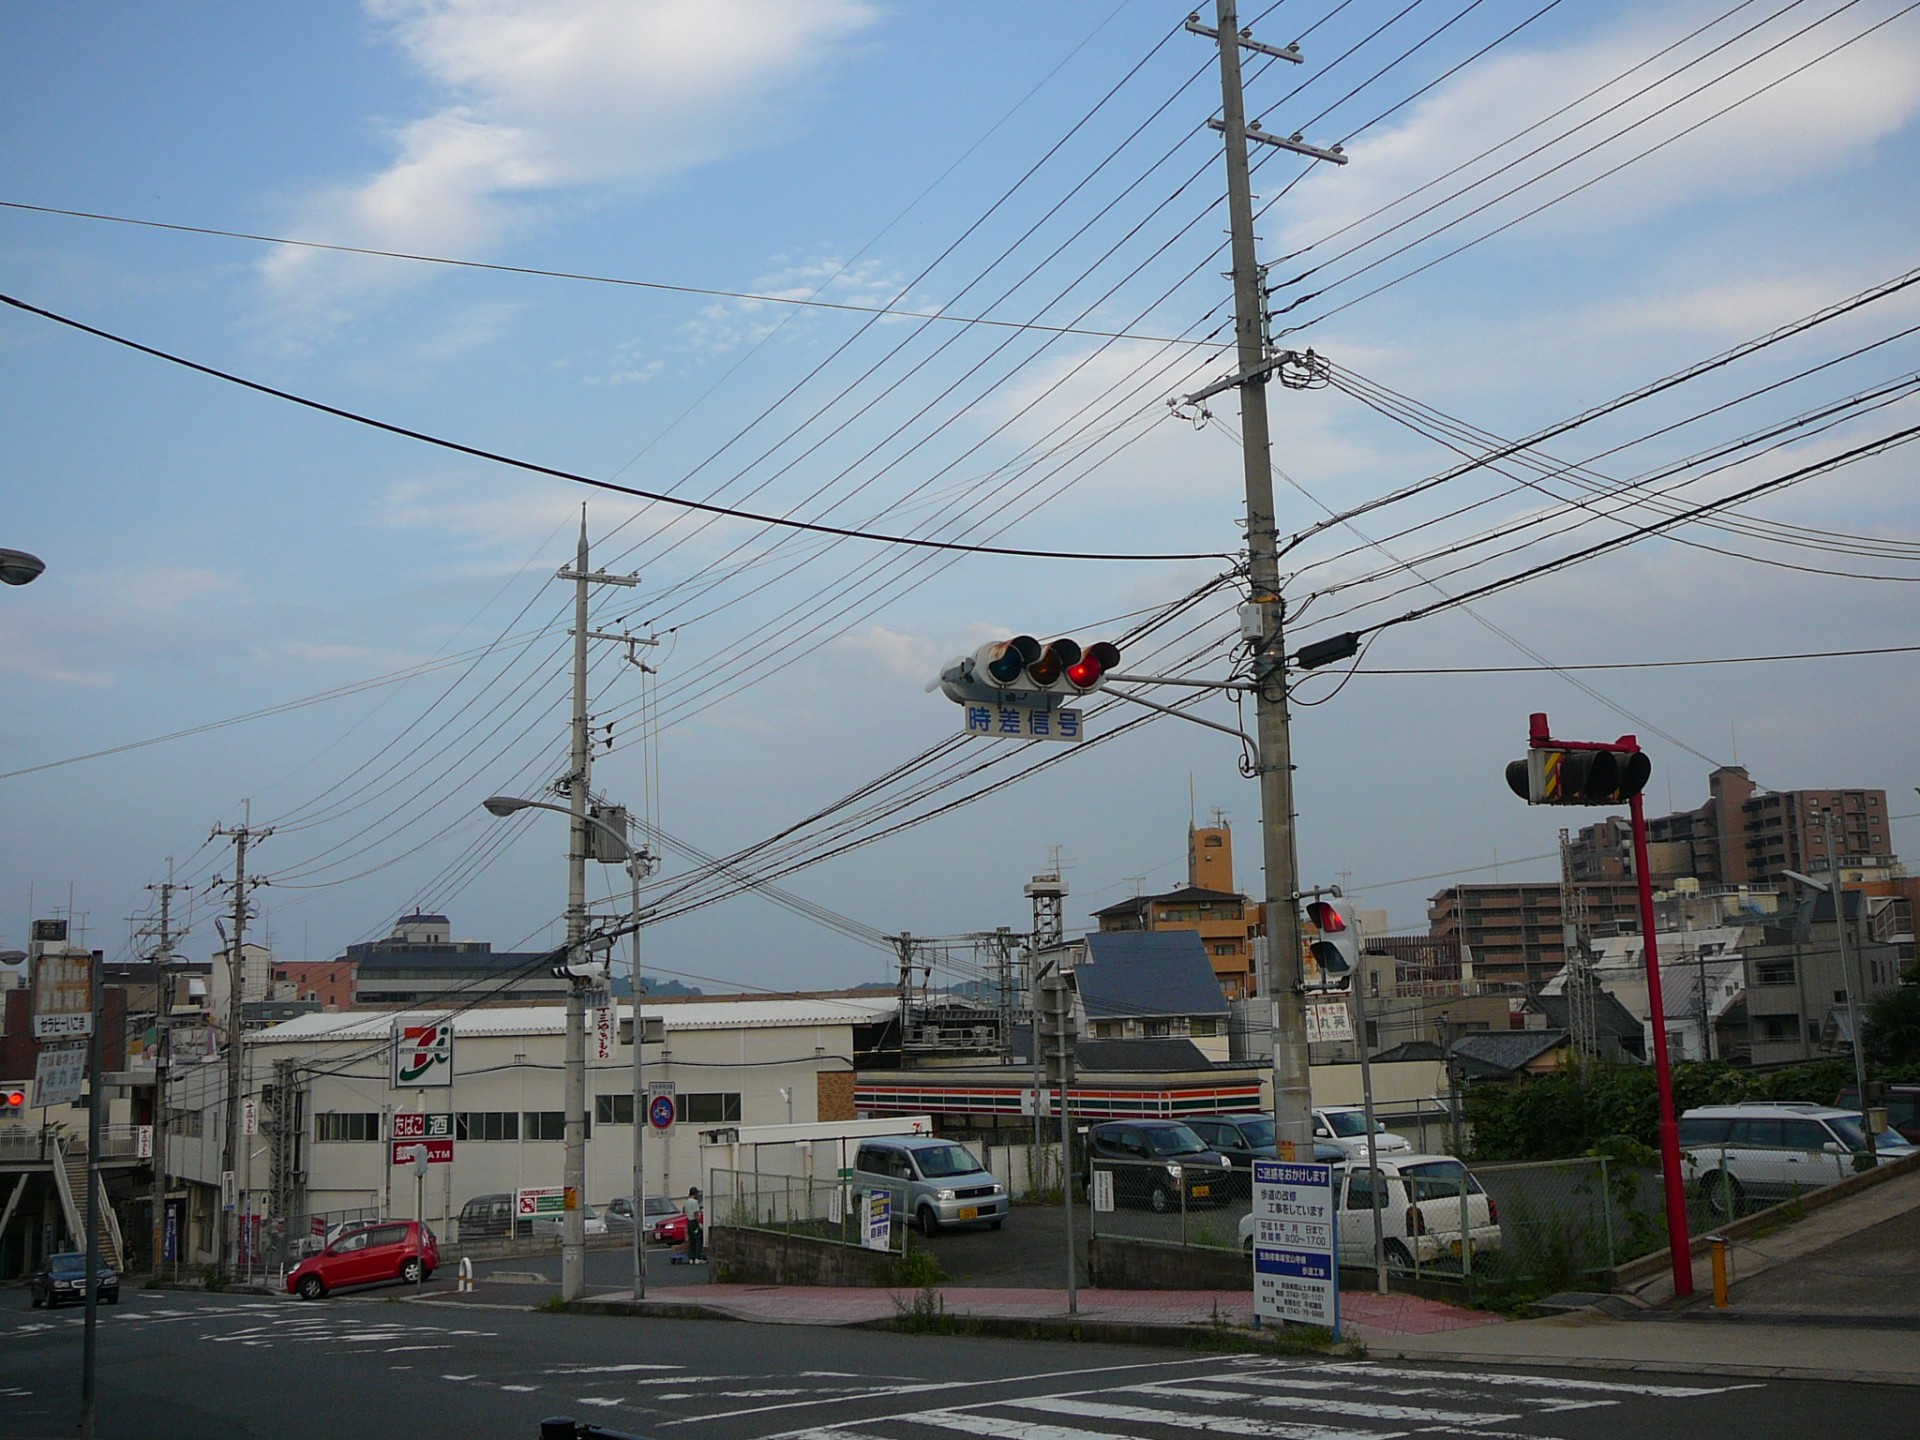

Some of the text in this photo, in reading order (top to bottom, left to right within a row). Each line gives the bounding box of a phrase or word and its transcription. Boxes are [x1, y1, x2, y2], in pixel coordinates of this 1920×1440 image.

[968, 706, 1080, 738] 時差信号
[394, 1116, 423, 1136] たばこ
[430, 1115, 448, 1134] 酒
[427, 1150, 450, 1160] ATM
[1257, 1168, 1326, 1182] ご迷惑をおかけします
[1261, 1190, 1297, 1202] 歩道の改修
[1268, 1203, 1324, 1218] 工事をしています
